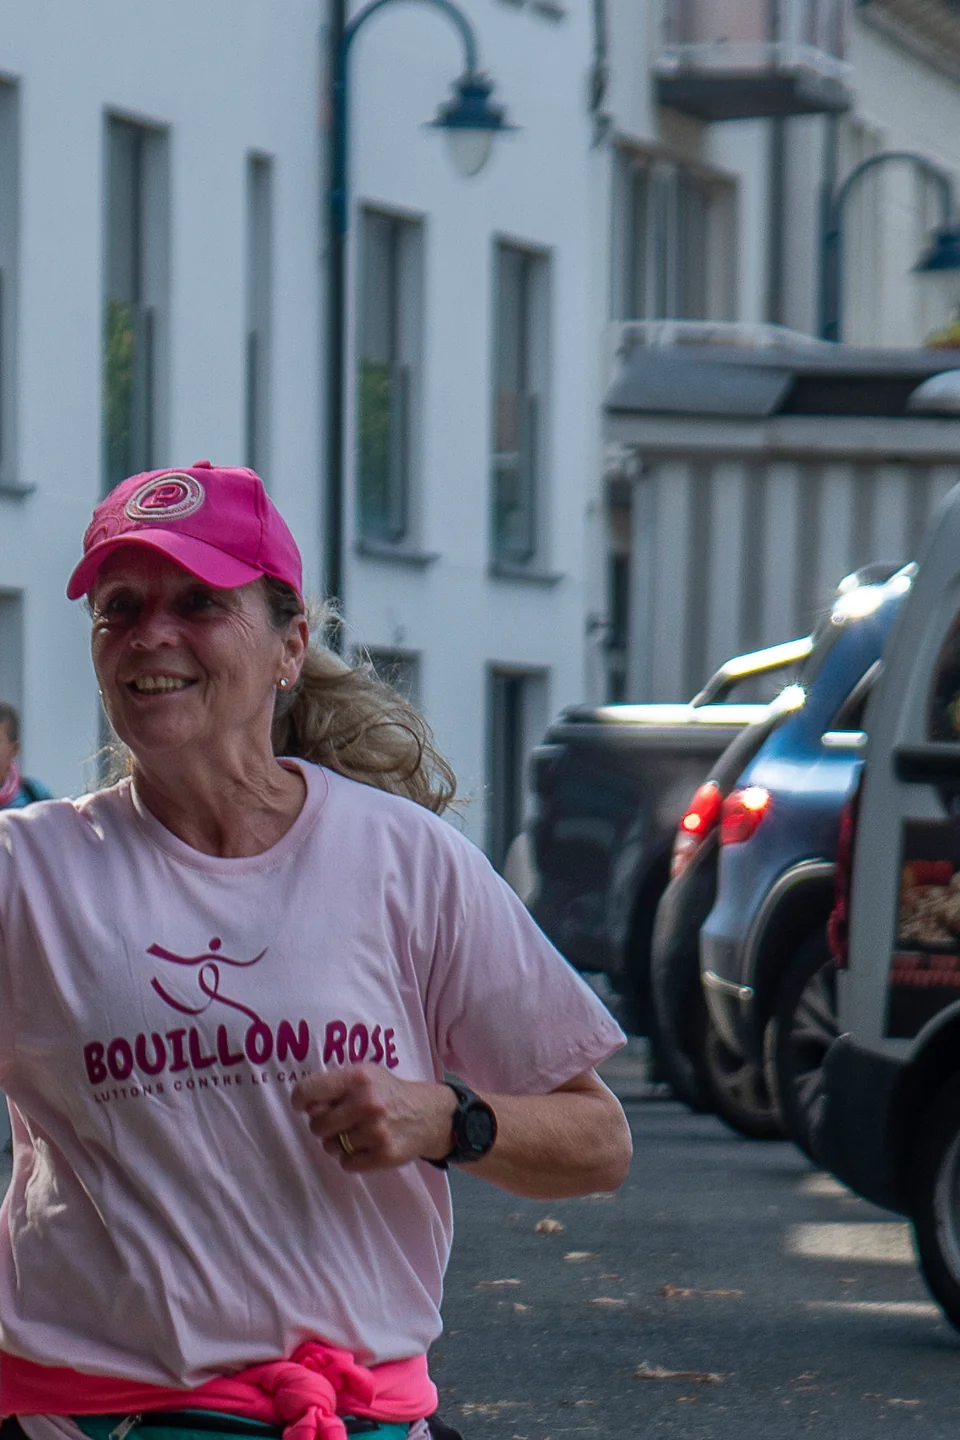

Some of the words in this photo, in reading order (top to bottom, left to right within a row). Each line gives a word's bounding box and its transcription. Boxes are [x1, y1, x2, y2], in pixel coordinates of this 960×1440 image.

[84, 1019, 310, 1086] BOUILLON
[324, 1019, 400, 1070] ROSE
[93, 1083, 164, 1104] LUTTONS
[173, 1073, 242, 1092] CONTRE
[251, 1071, 268, 1085] LE
